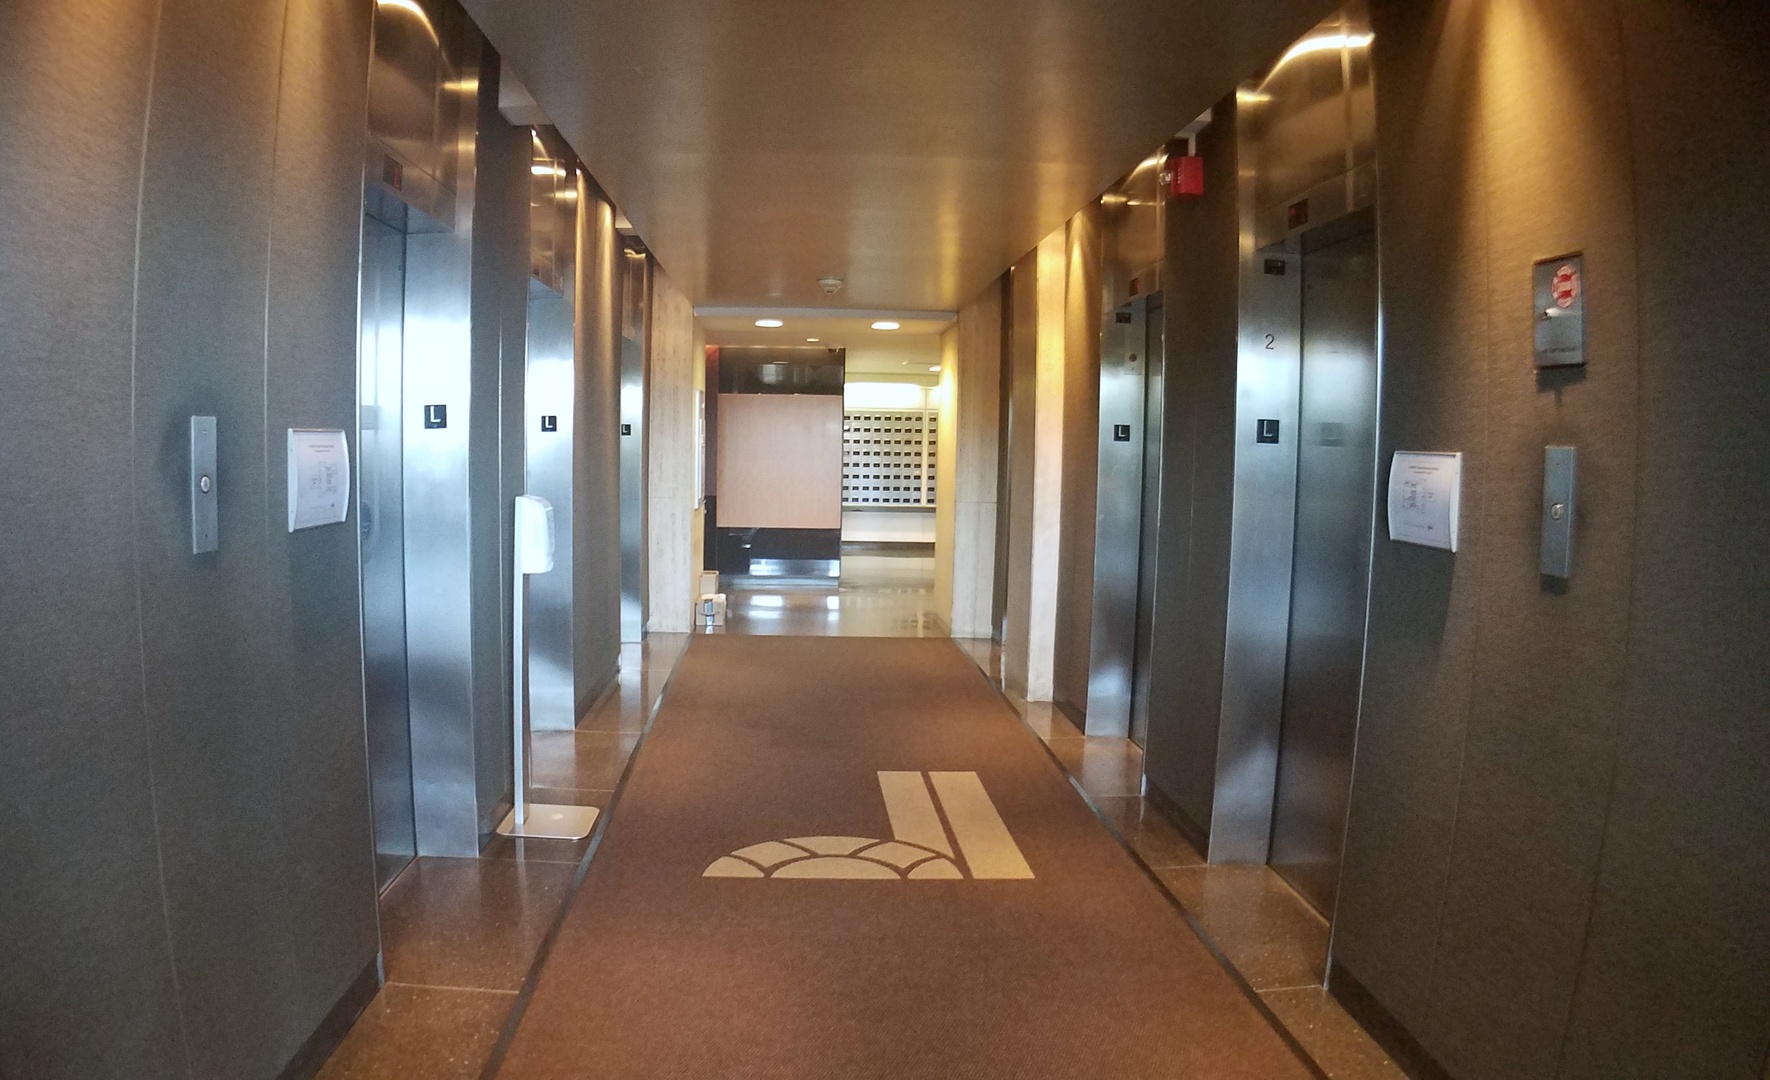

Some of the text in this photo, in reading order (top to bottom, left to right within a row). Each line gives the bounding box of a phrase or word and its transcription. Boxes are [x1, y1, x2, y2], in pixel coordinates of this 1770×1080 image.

[1265, 334, 1274, 350] 2
[430, 405, 441, 423] L
[545, 415, 554, 429] L
[1118, 425, 1126, 437] L
[1263, 420, 1273, 437] L
